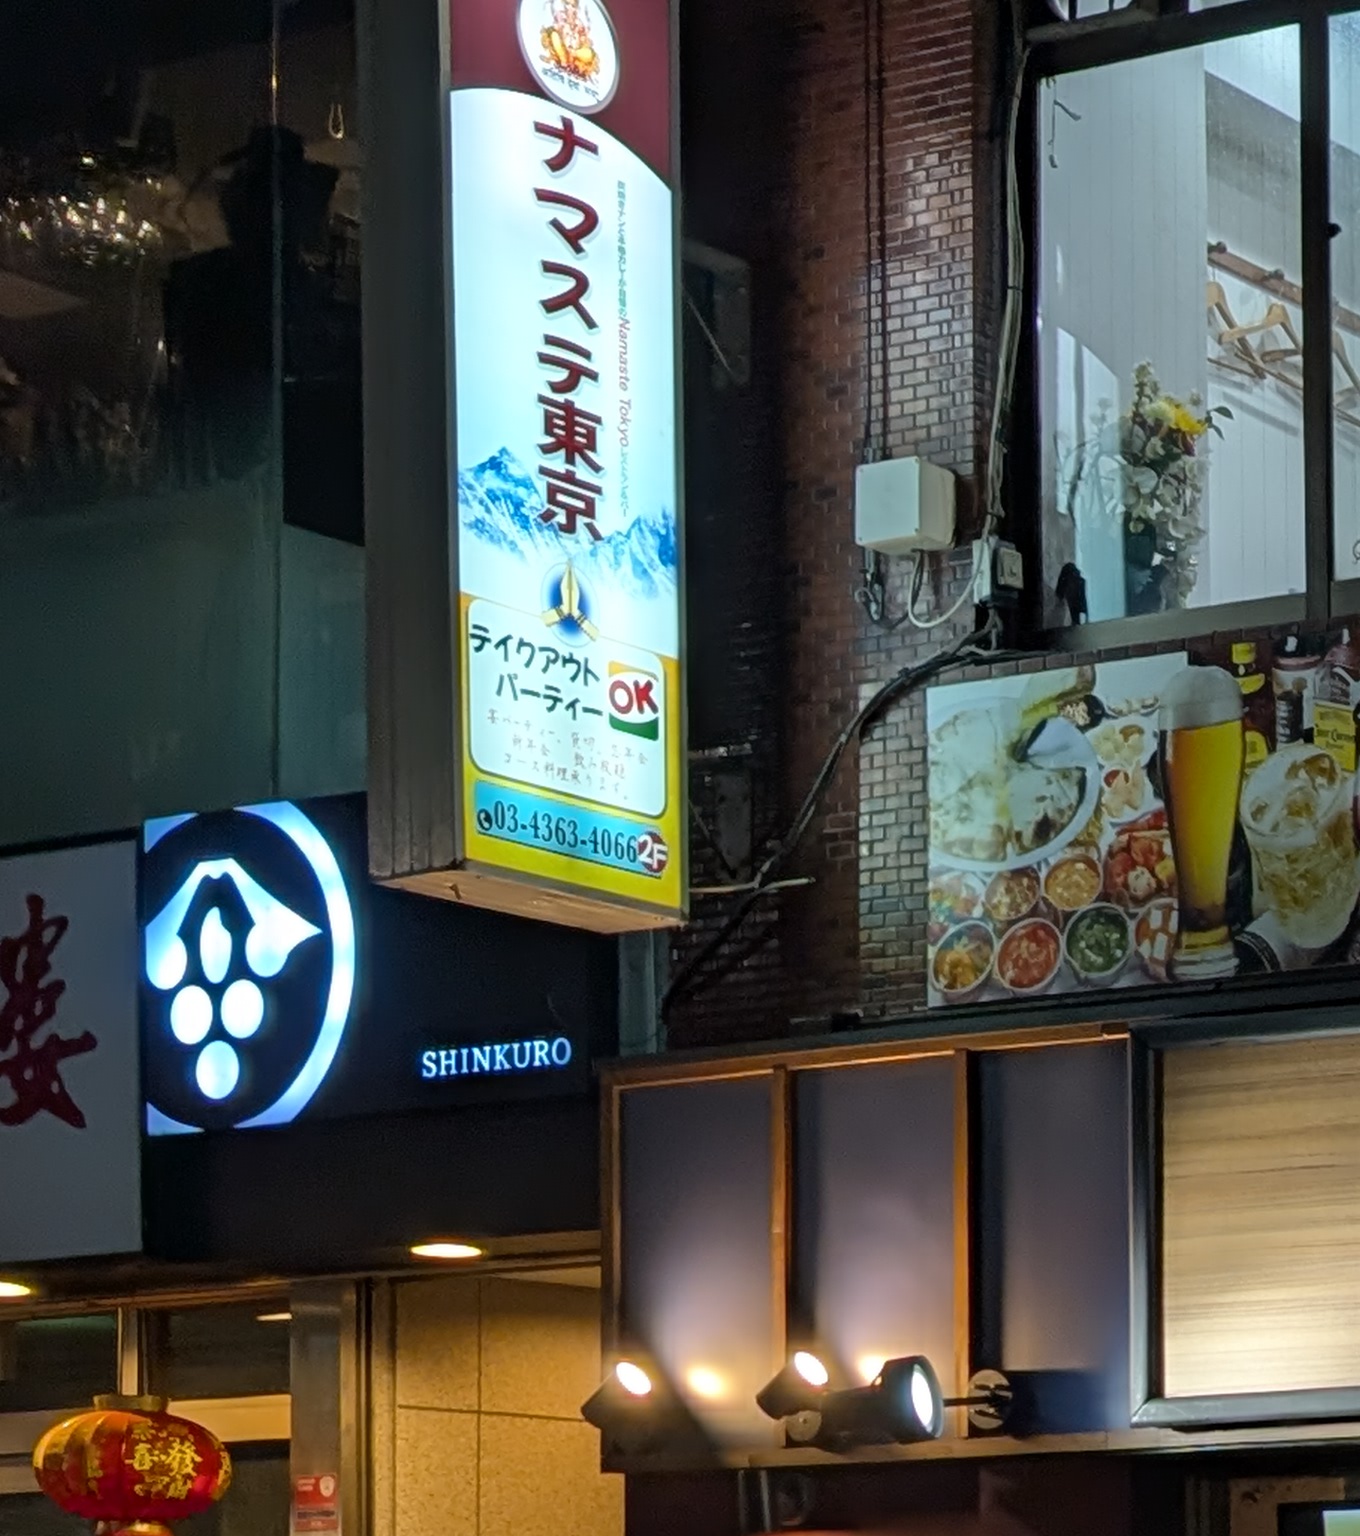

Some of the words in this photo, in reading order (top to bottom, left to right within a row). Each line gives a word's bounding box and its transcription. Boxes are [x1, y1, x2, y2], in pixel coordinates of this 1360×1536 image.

[533, 114, 606, 542] ナマステ東京
[616, 317, 632, 392] Namaste
[616, 398, 632, 448] Tokyo
[469, 624, 601, 688] テイクアウト
[496, 672, 604, 721] パーティー
[609, 679, 659, 716] OK
[494, 800, 638, 864] 03-4363-4066
[638, 834, 669, 870] 2F
[421, 1037, 572, 1079] SHINKURO
